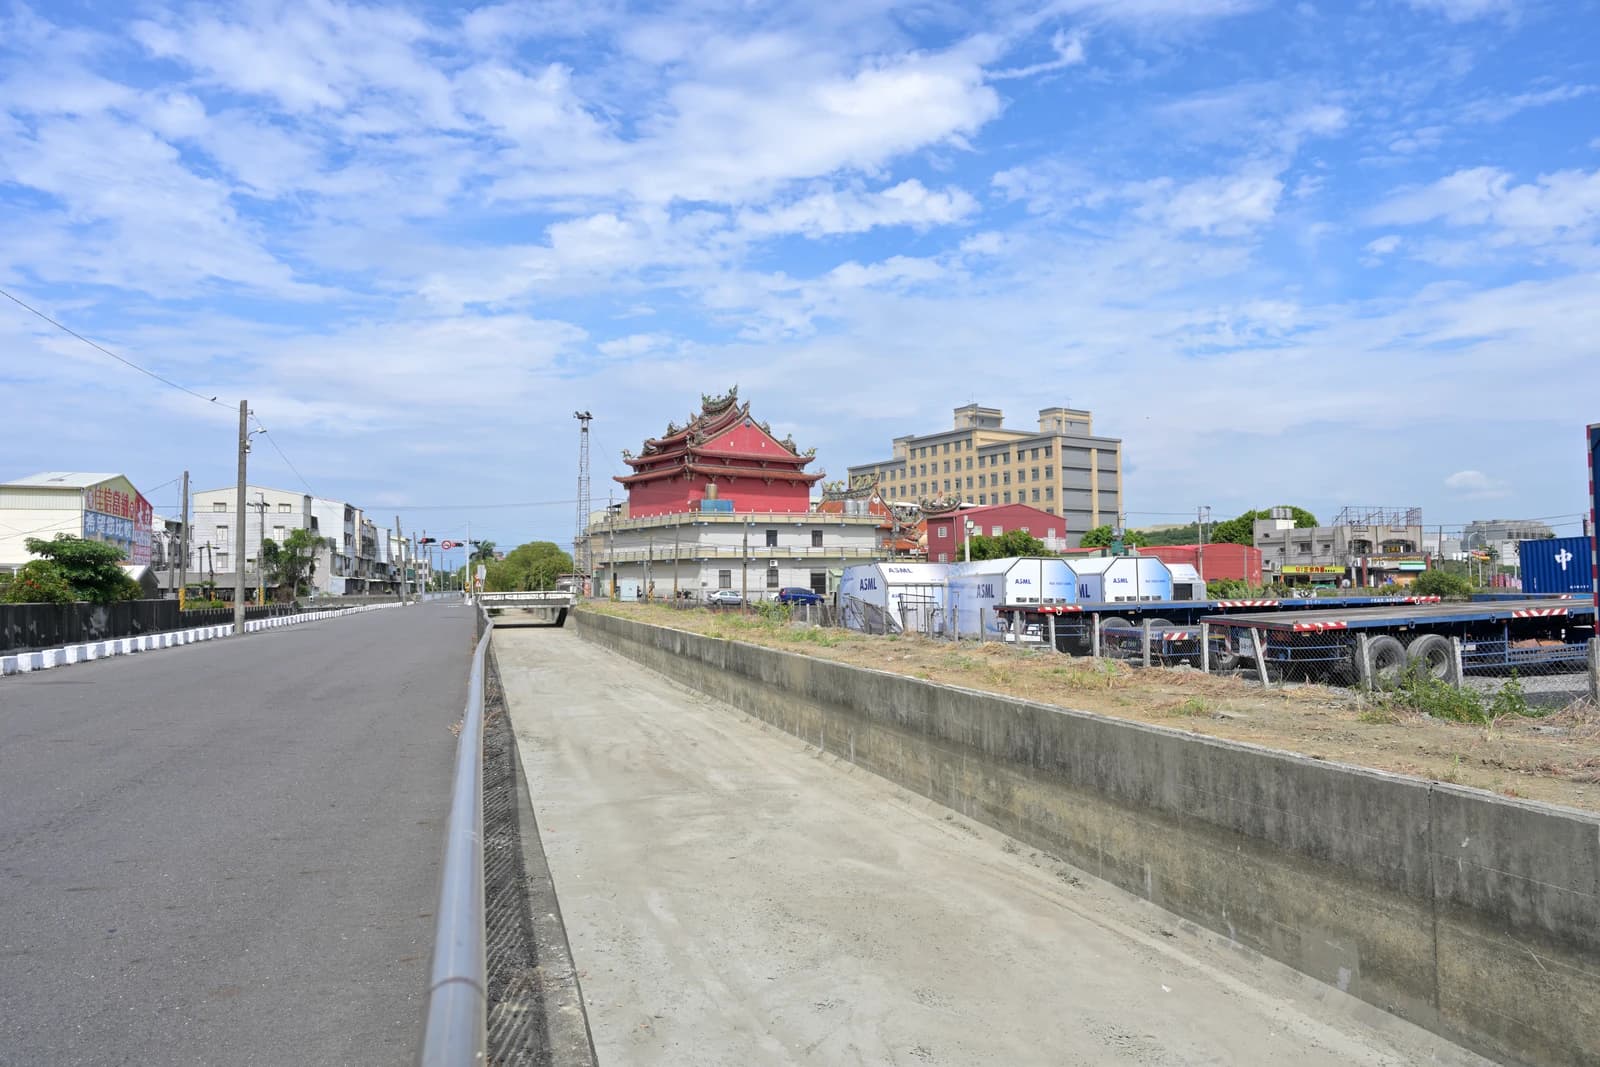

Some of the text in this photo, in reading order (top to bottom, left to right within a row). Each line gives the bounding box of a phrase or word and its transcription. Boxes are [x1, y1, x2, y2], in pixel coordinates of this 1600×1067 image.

[1554, 548, 1573, 571] 中
[859, 577, 877, 592] ASML
[976, 583, 995, 599] ASML
[1078, 583, 1091, 599] ML
